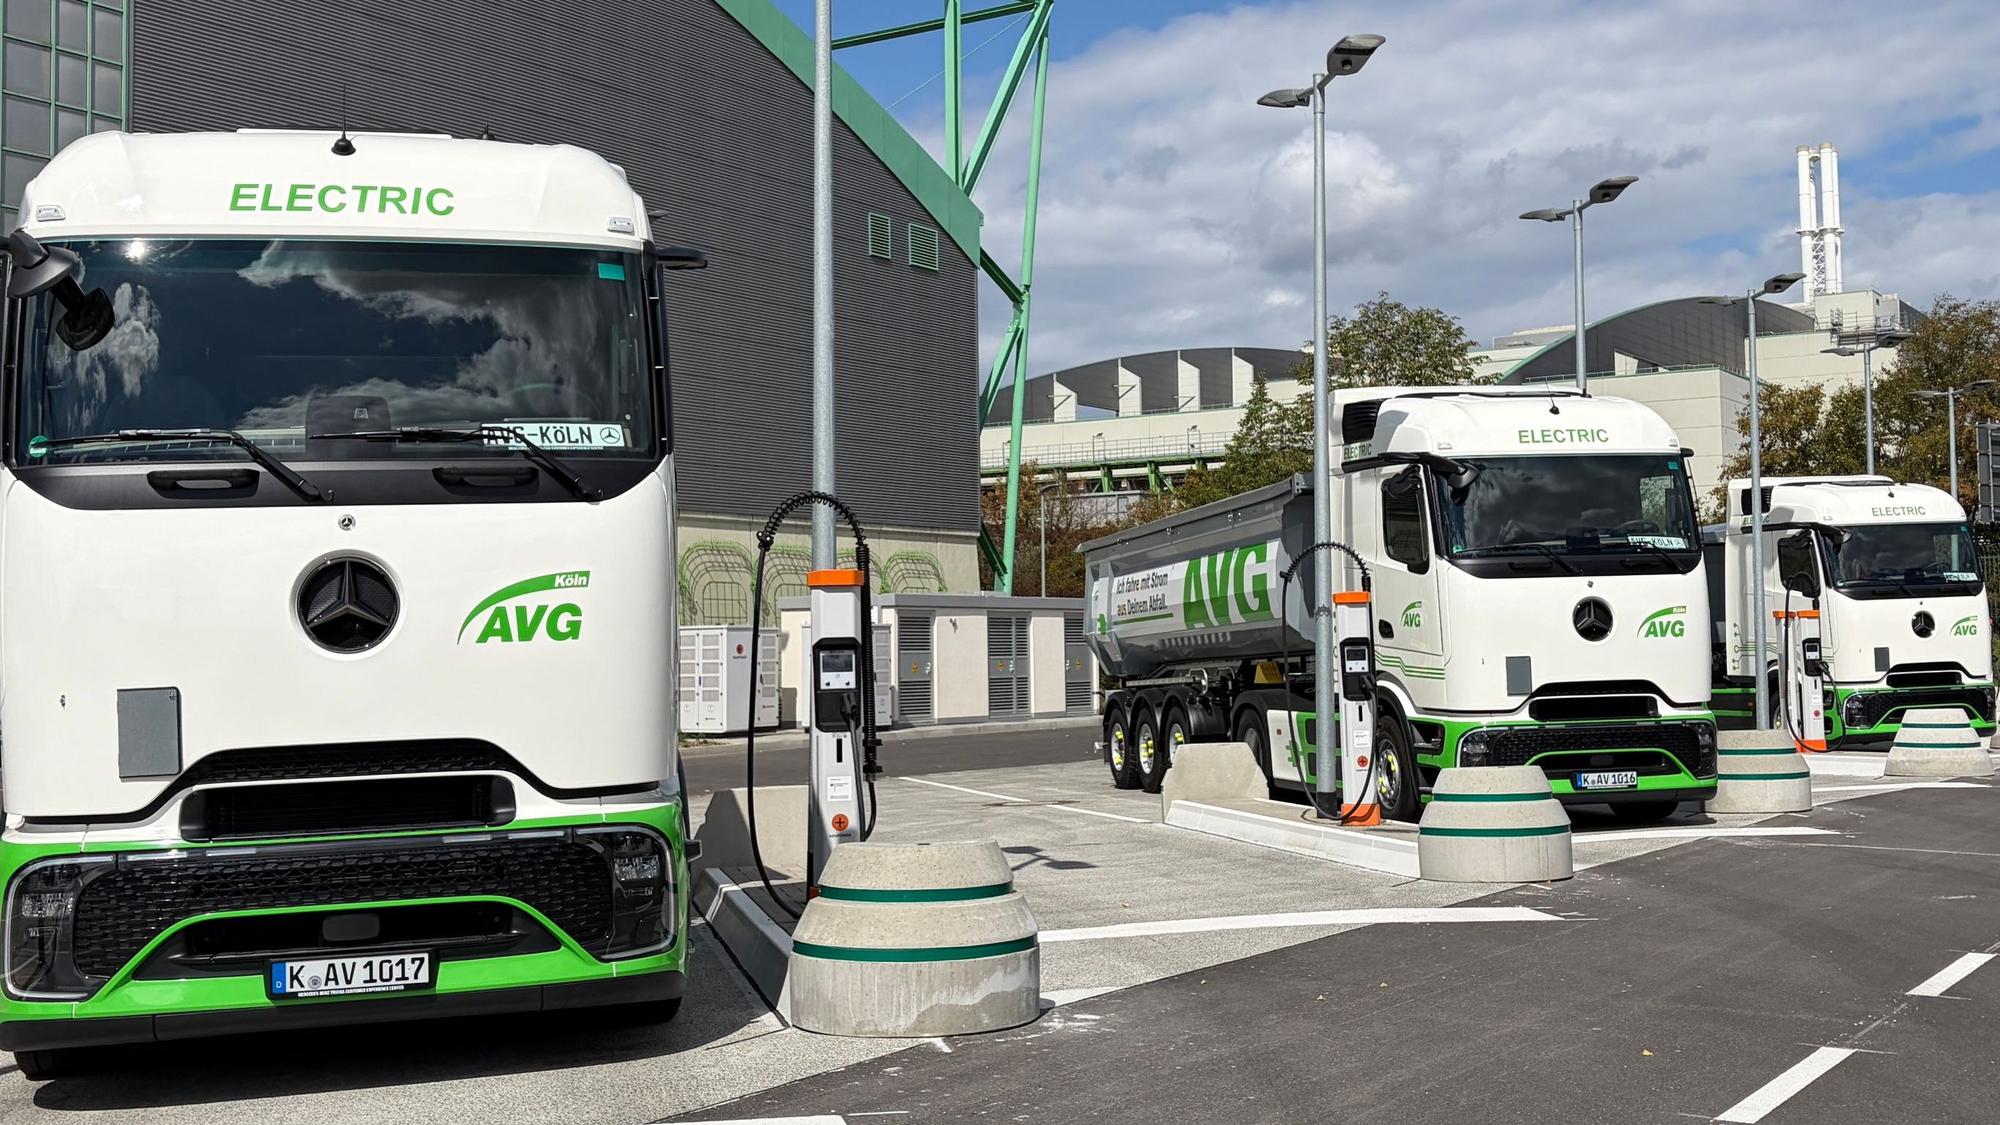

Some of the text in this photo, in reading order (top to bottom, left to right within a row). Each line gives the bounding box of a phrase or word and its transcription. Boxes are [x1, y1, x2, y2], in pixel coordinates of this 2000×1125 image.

[229, 183, 455, 215] ELECTRIC
[1518, 429, 1609, 443] ELECTRIC
[1343, 444, 1372, 460] ELECTRIC
[1871, 506, 1926, 516] ELECTRIC
[554, 574, 588, 588] Köln
[1117, 572, 1169, 595] Ich fahre mit Strom
[1183, 542, 1271, 629] AVG
[1117, 603, 1127, 616] aus
[1127, 598, 1148, 615] Deinem
[475, 603, 582, 643] AVG
[1403, 612, 1421, 627] AVG
[1644, 620, 1685, 638] AVG
[1954, 624, 1977, 636] AVG
[1583, 773, 1636, 785] K AV 1016
[289, 957, 425, 989] K AV 1017
